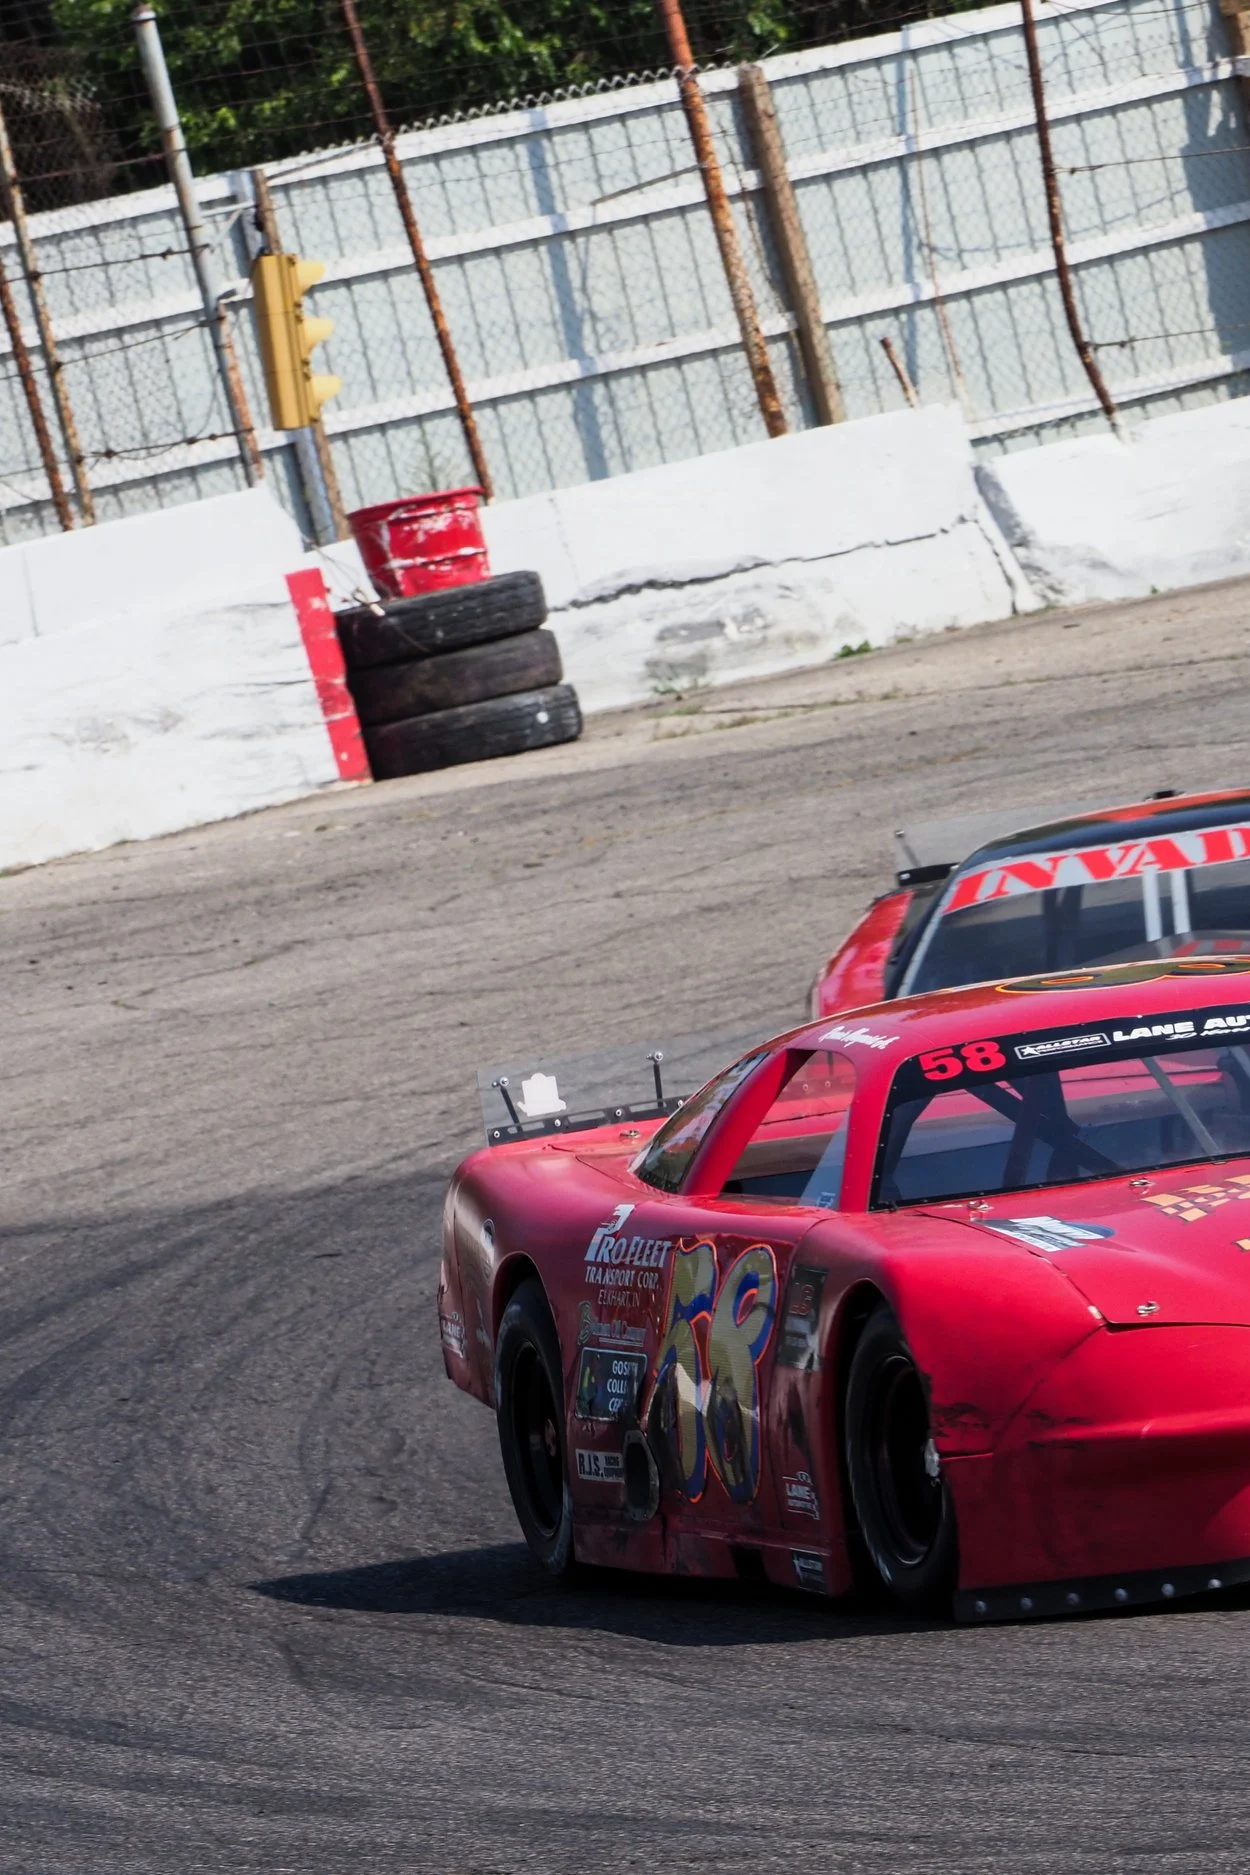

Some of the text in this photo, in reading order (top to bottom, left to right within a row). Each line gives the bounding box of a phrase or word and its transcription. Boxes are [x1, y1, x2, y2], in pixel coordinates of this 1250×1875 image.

[1112, 1021, 1196, 1042] LANE
[918, 1041, 1007, 1081] 58
[584, 1204, 673, 1268] PRO FLEET
[585, 1266, 636, 1287] TRANSPORT
[645, 1237, 779, 1503] 58
